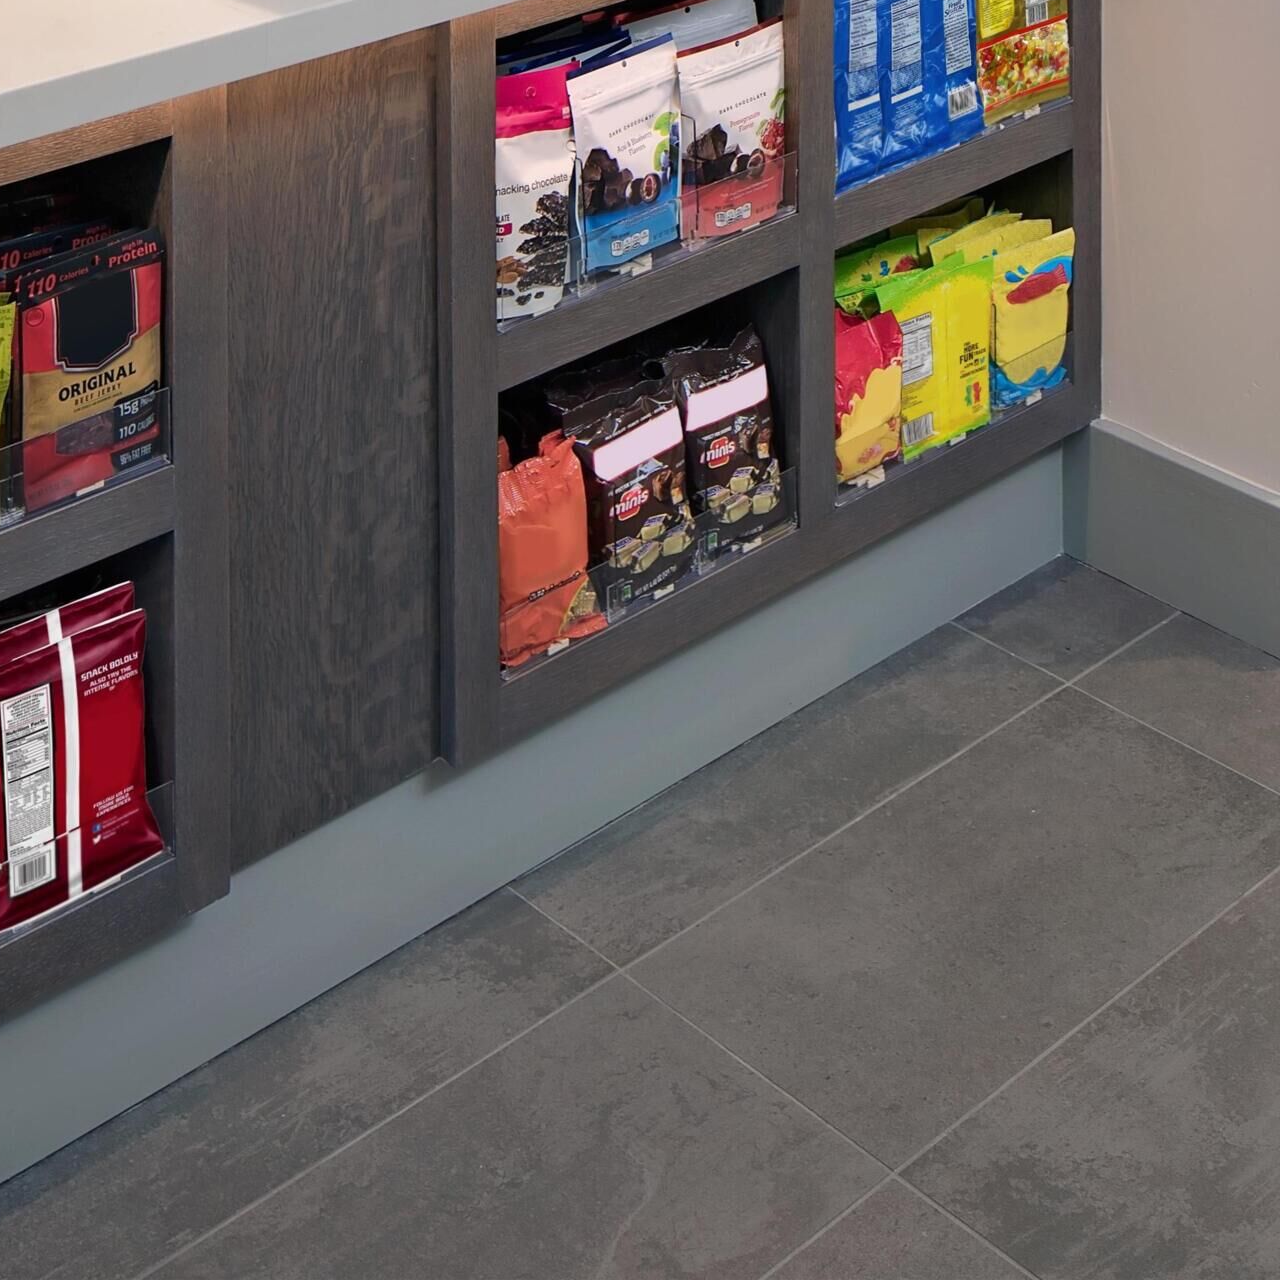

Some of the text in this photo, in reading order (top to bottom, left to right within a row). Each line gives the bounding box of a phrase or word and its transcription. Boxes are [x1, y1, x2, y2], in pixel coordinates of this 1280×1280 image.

[735, 91, 767, 108] CHOCOLATE
[496, 174, 568, 196] nacking chocolate
[23, 245, 53, 260] Calories
[121, 240, 136, 252] High
[28, 240, 157, 298] 110 Calories Protein
[964, 343, 979, 352] MORE
[960, 351, 973, 364] FUN
[58, 362, 136, 402] ORIGINAL
[74, 382, 121, 406] BEEF JERKY
[119, 399, 139, 416] 15g
[119, 423, 136, 438] 110
[141, 443, 152, 457] FREE
[699, 440, 736, 464] minis
[609, 487, 648, 517] minis
[81, 651, 139, 682] SNACK BOLDLY
[84, 669, 139, 696] INTENSE FLAVORS
[89, 665, 132, 688] ALSO THE
[5, 725, 29, 736] Nutrition
[93, 794, 115, 809] FOLLOW
[96, 797, 131, 817] EXPERIENCES
[98, 793, 129, 811] MORE BOLD
